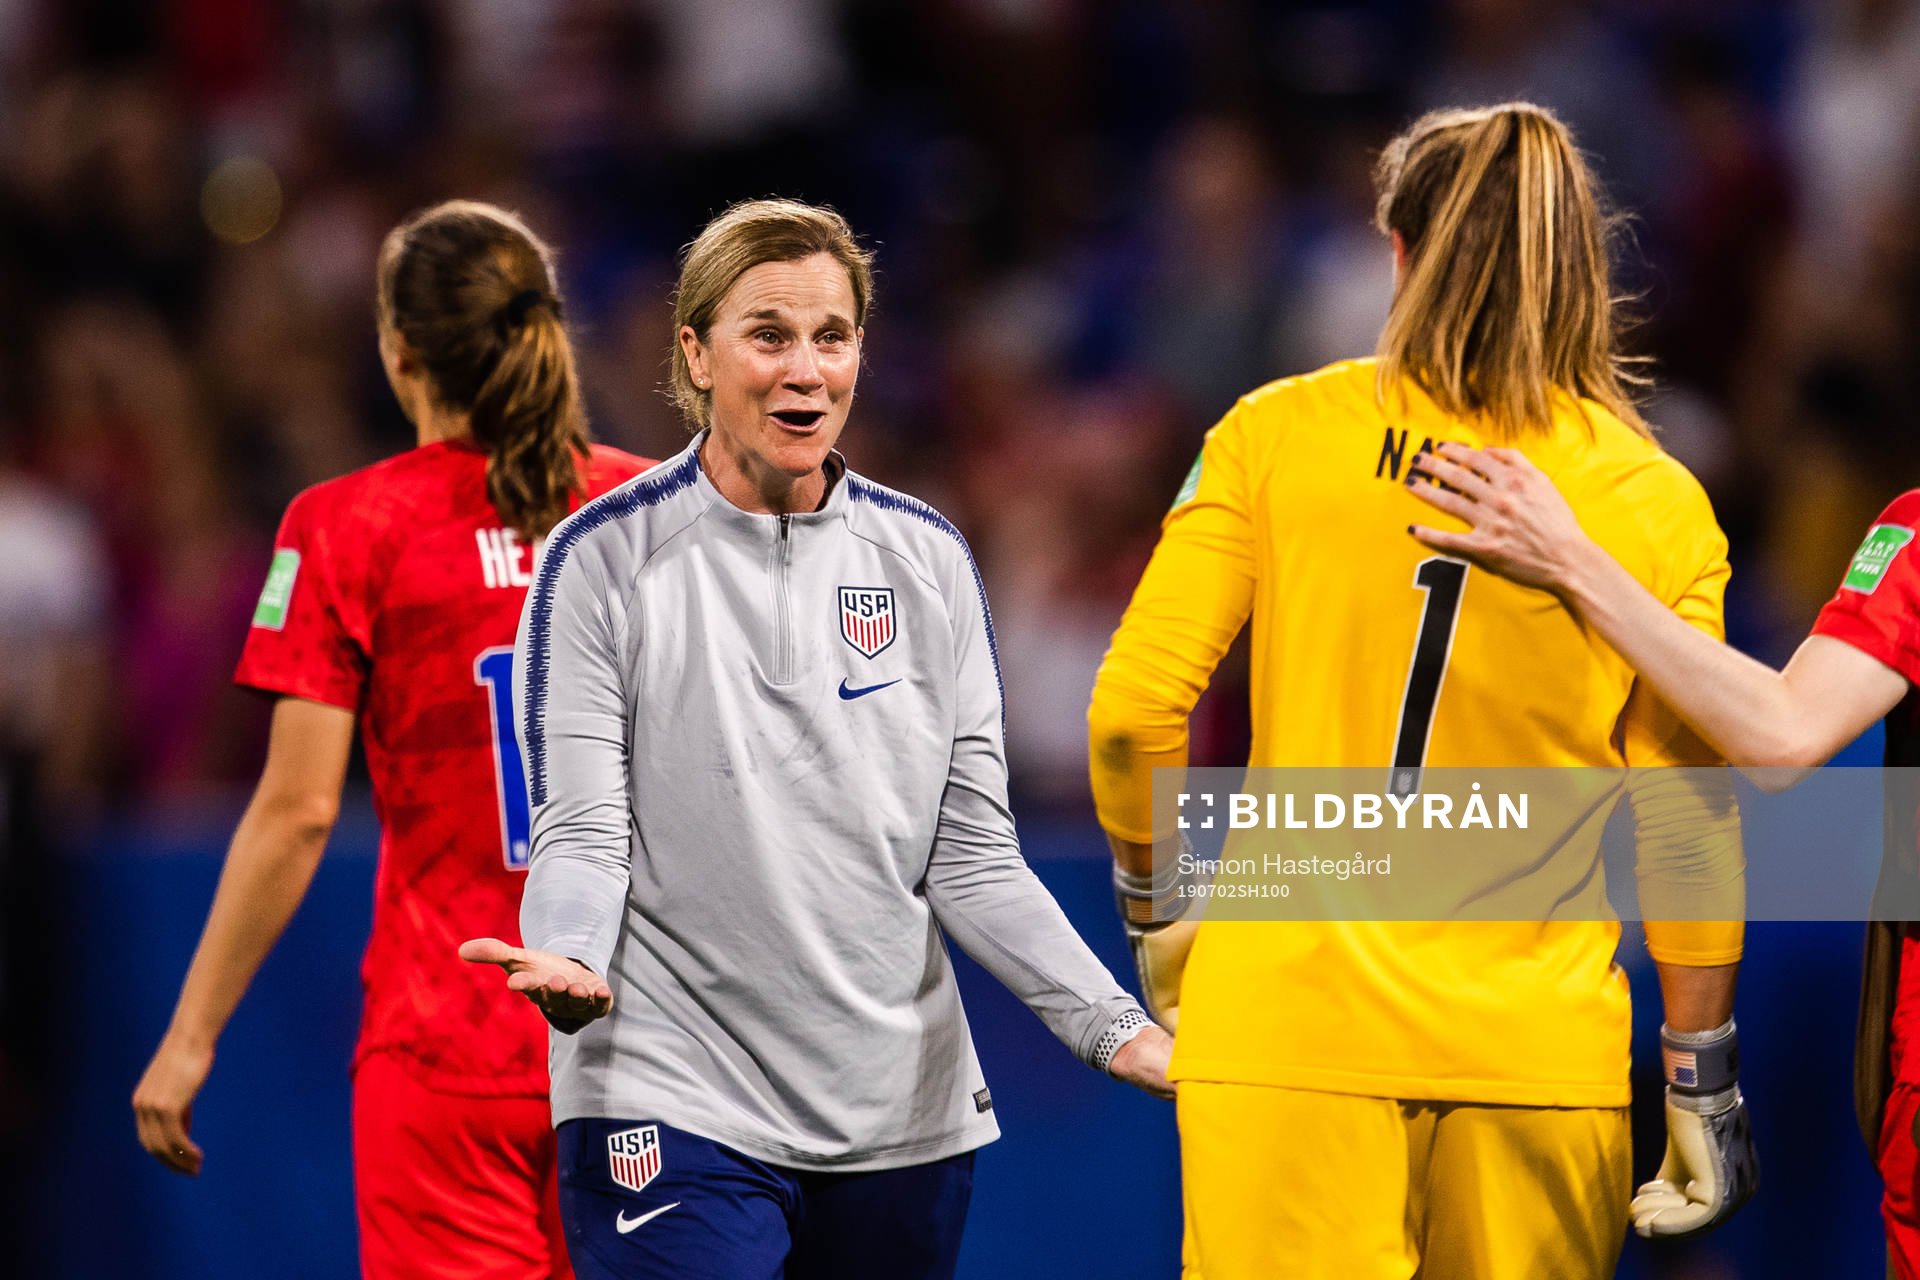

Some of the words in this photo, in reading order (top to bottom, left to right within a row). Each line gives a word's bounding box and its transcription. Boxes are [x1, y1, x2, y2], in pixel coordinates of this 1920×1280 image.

[844, 592, 888, 617] USA
[1386, 555, 1471, 801] 1
[473, 645, 530, 872] 1
[611, 1130, 656, 1155] USA
